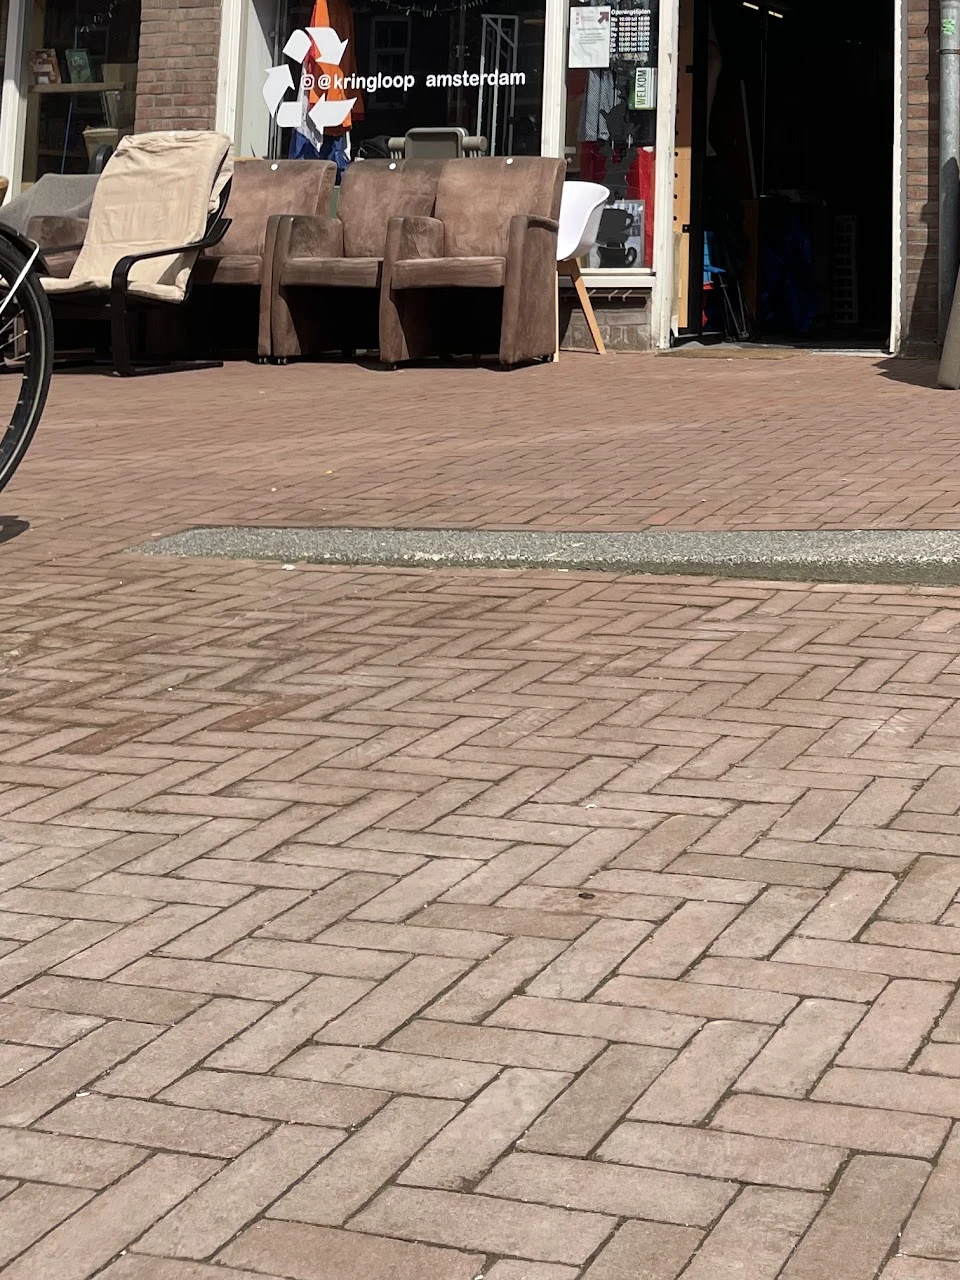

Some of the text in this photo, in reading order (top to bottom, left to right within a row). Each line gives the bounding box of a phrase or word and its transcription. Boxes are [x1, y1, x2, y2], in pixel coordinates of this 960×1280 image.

[318, 70, 526, 91] @kringloop amsterdam
[636, 69, 647, 106] WELKOM
